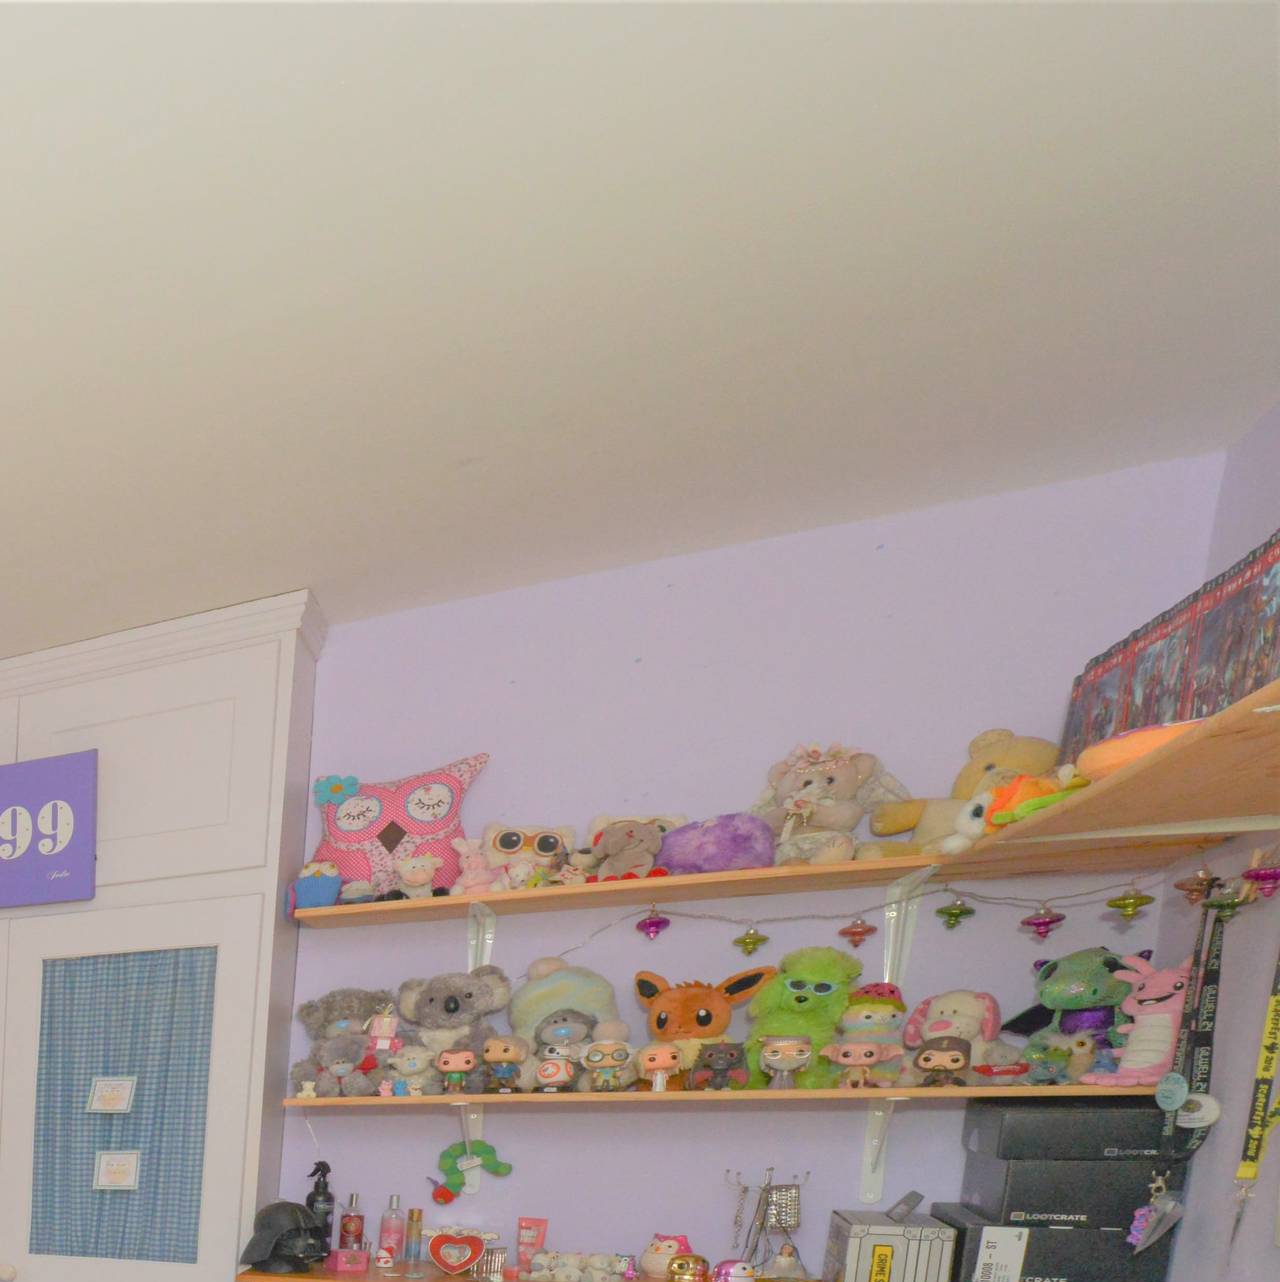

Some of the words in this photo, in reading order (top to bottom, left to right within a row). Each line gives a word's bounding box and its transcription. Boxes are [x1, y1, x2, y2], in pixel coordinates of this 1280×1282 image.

[1203, 985, 1218, 1019] GILWELL
[1201, 1021, 1215, 1032] 24
[1196, 1046, 1210, 1080] GILWELL
[1195, 1082, 1208, 1093] 24
[1252, 1084, 1268, 1125] SCAREFEST
[1026, 1213, 1088, 1222] LOOTCRATE
[875, 1254, 888, 1277] CRIME
